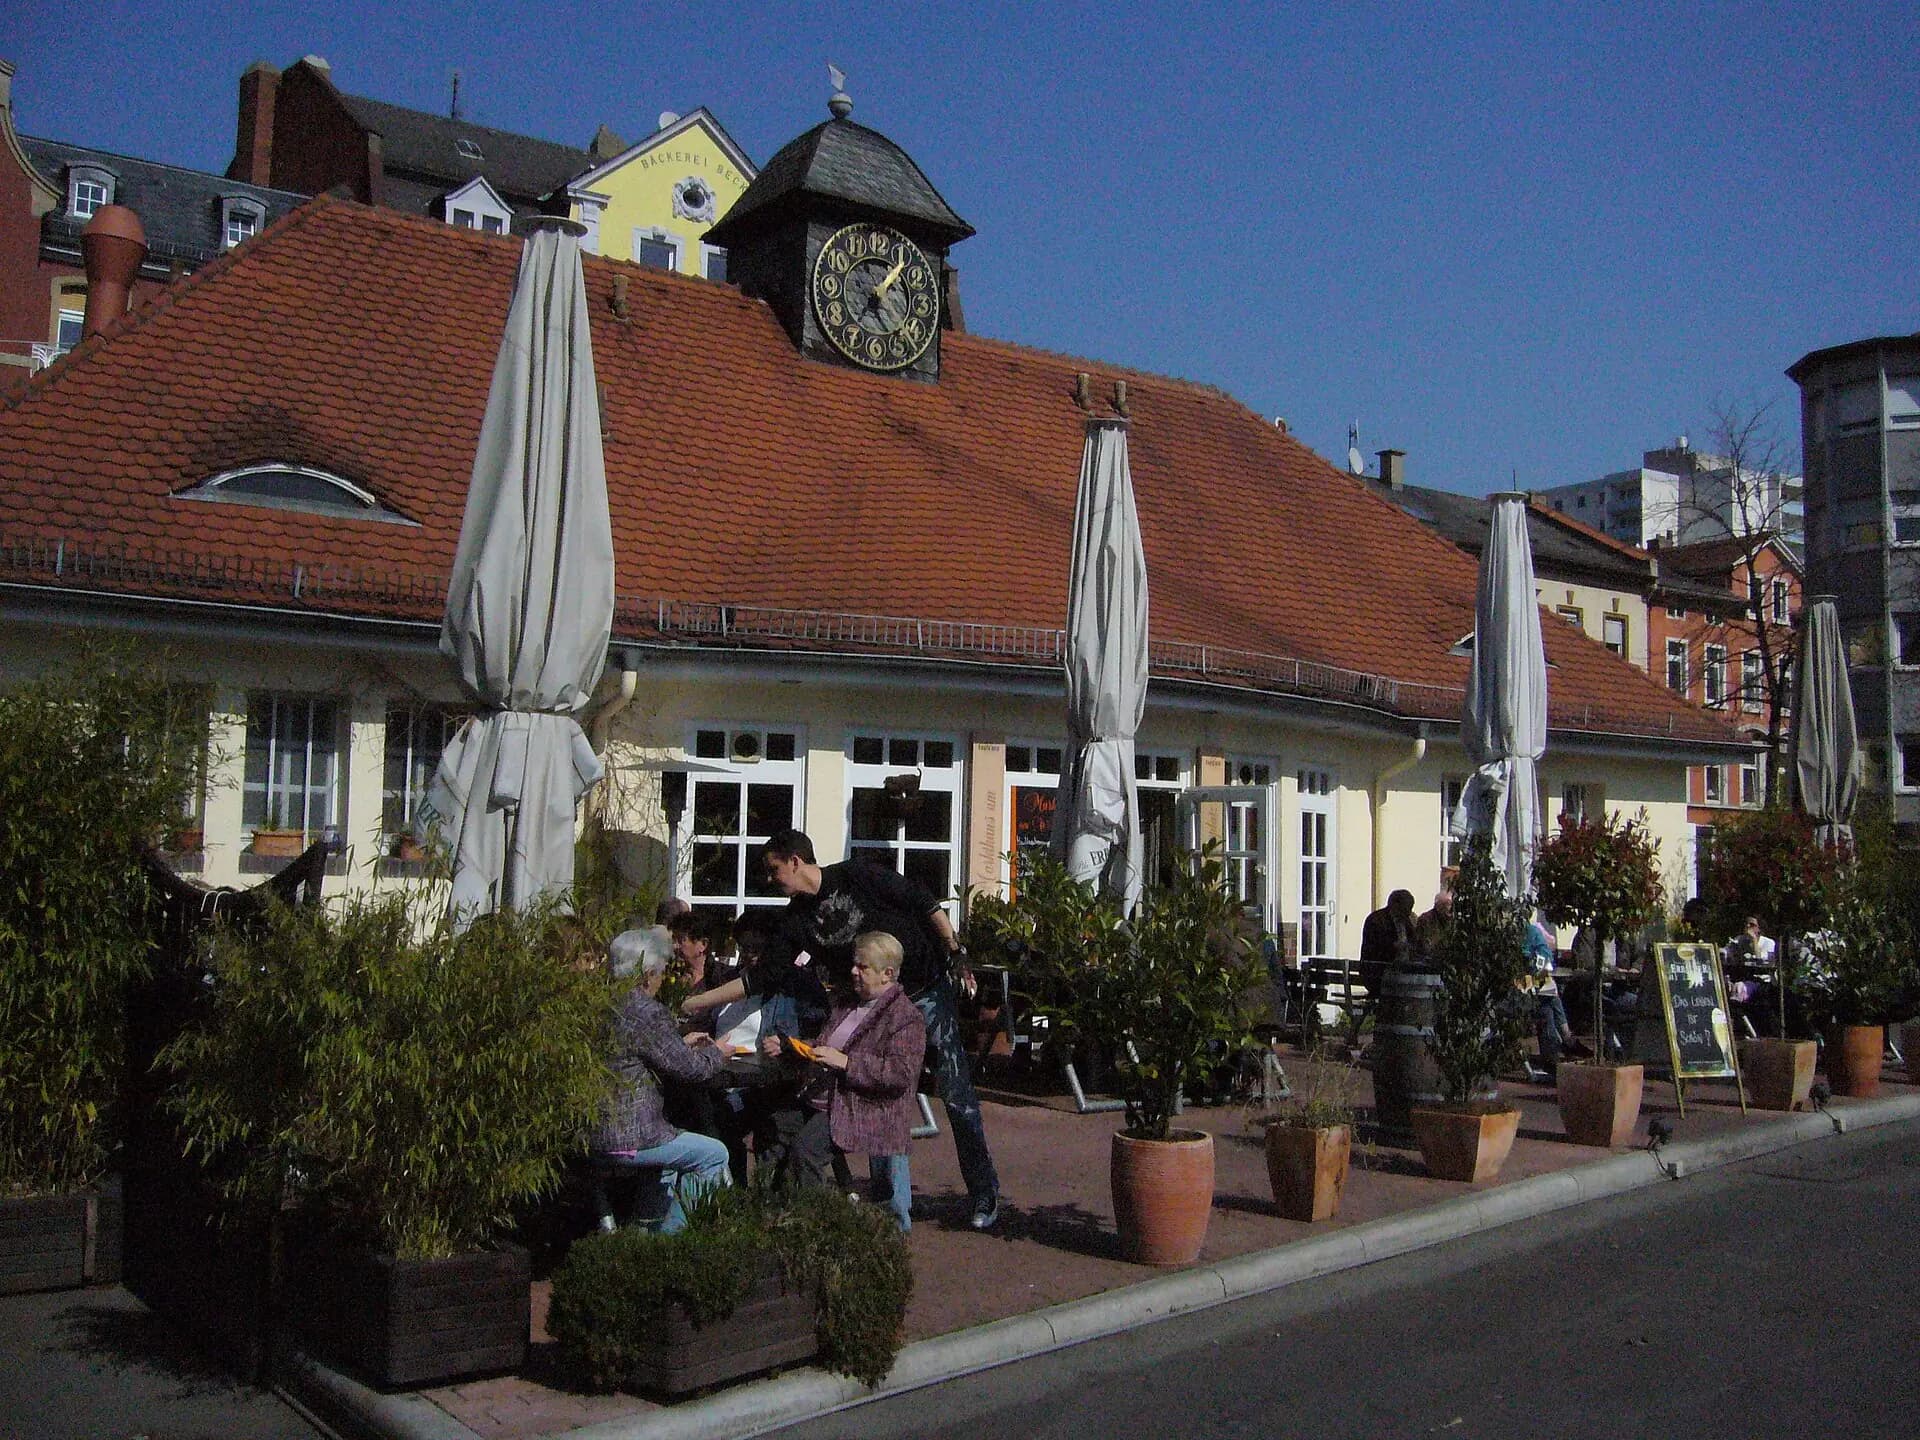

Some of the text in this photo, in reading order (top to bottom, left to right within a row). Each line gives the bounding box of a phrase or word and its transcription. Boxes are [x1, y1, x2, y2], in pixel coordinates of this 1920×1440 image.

[848, 234, 863, 257] 11
[872, 231, 888, 254] 12
[829, 250, 848, 273] 10
[824, 276, 839, 296] 9
[911, 268, 924, 289] 2
[829, 302, 843, 326] 8
[915, 295, 929, 316] 3
[847, 326, 861, 348] 7
[906, 319, 922, 342] 4
[869, 338, 882, 359] 6
[892, 334, 905, 357] 5
